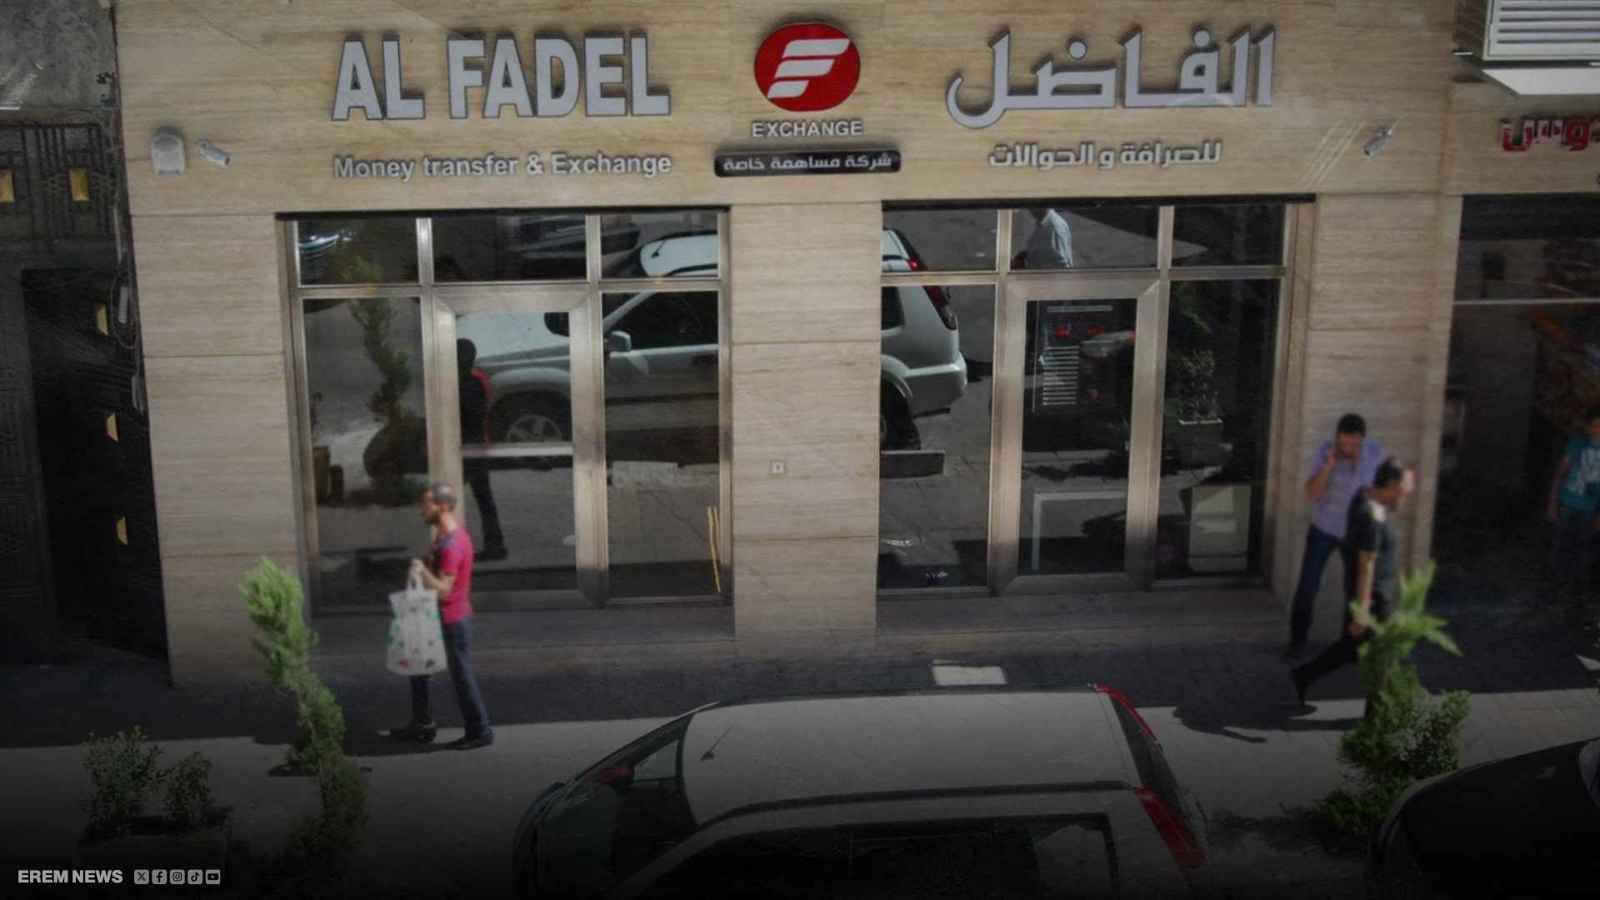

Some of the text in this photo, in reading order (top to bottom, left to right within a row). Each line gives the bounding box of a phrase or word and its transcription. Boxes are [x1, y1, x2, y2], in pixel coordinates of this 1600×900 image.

[331, 35, 672, 121] AL FADEL
[946, 27, 1276, 129] الفاضل
[751, 120, 864, 138] EXCHANGE
[333, 152, 673, 182] Money transfer & Exchange
[723, 152, 892, 172] شركة مساهمة خاصة
[988, 140, 1223, 170] للصرافة و الحوالات
